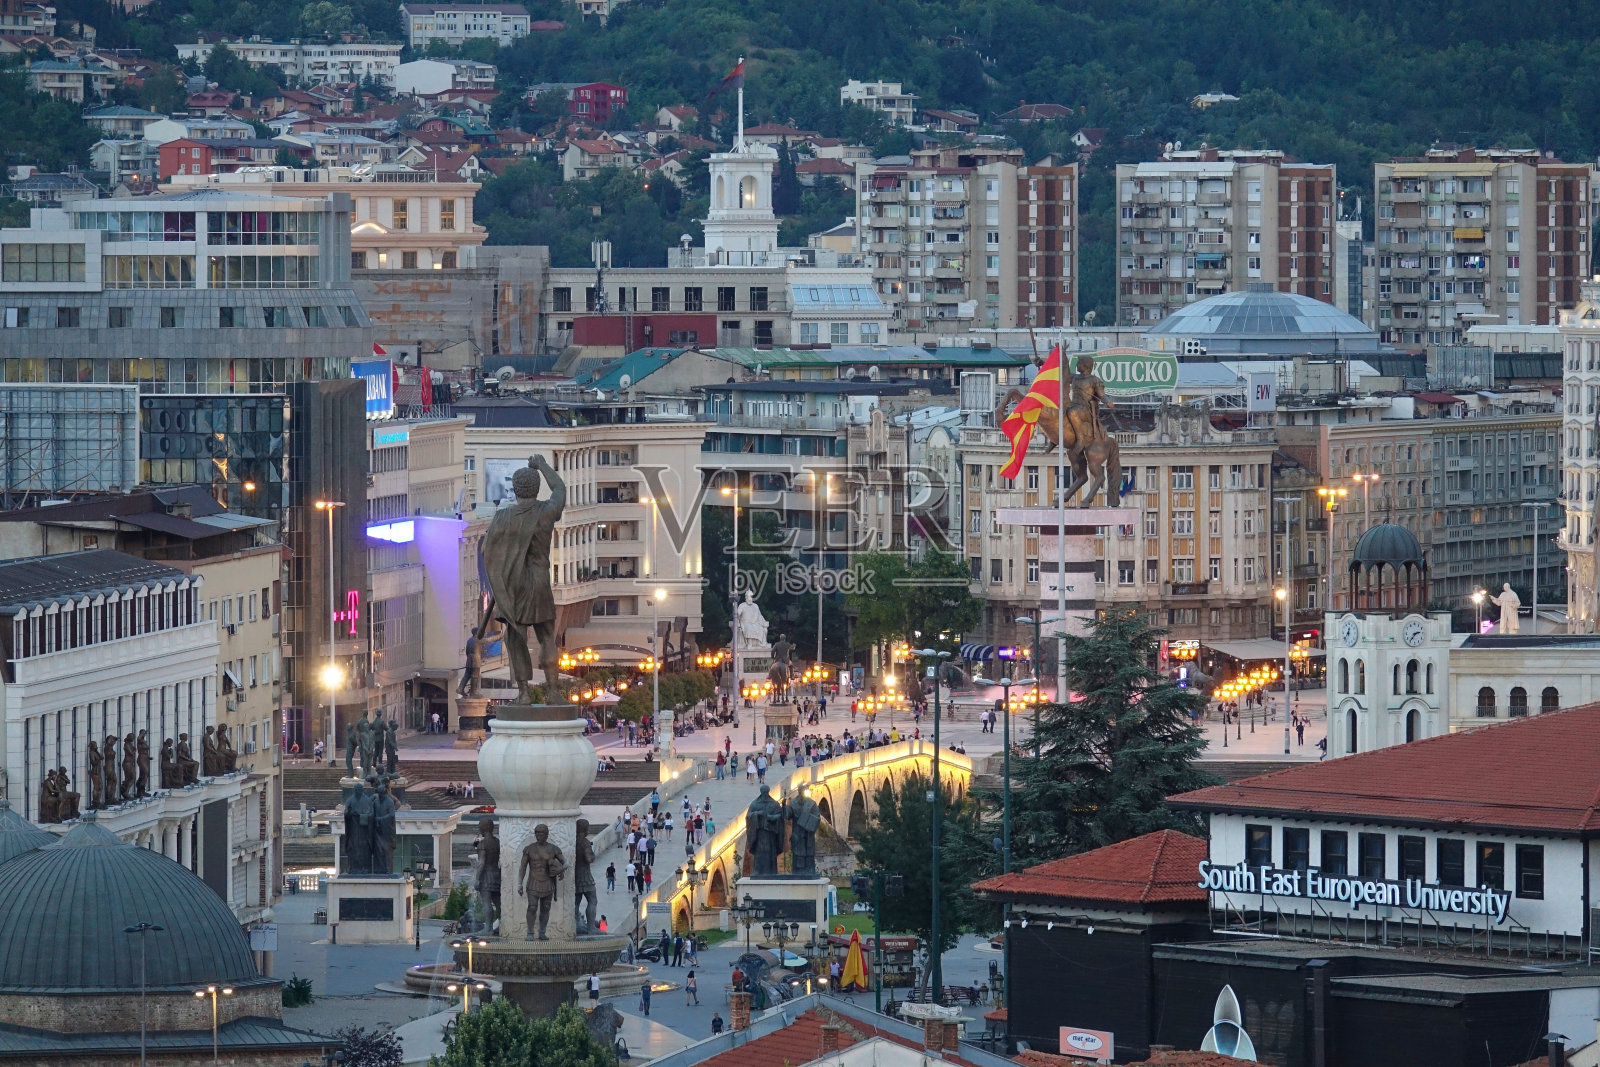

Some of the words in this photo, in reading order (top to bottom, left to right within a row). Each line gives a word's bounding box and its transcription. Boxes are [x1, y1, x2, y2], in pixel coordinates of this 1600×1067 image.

[1077, 361, 1173, 383] КОПСКО
[1256, 384, 1271, 400] EVN
[1197, 860, 1255, 893] South
[1260, 865, 1301, 896] East
[1306, 869, 1400, 909] European
[1406, 878, 1508, 925] University
